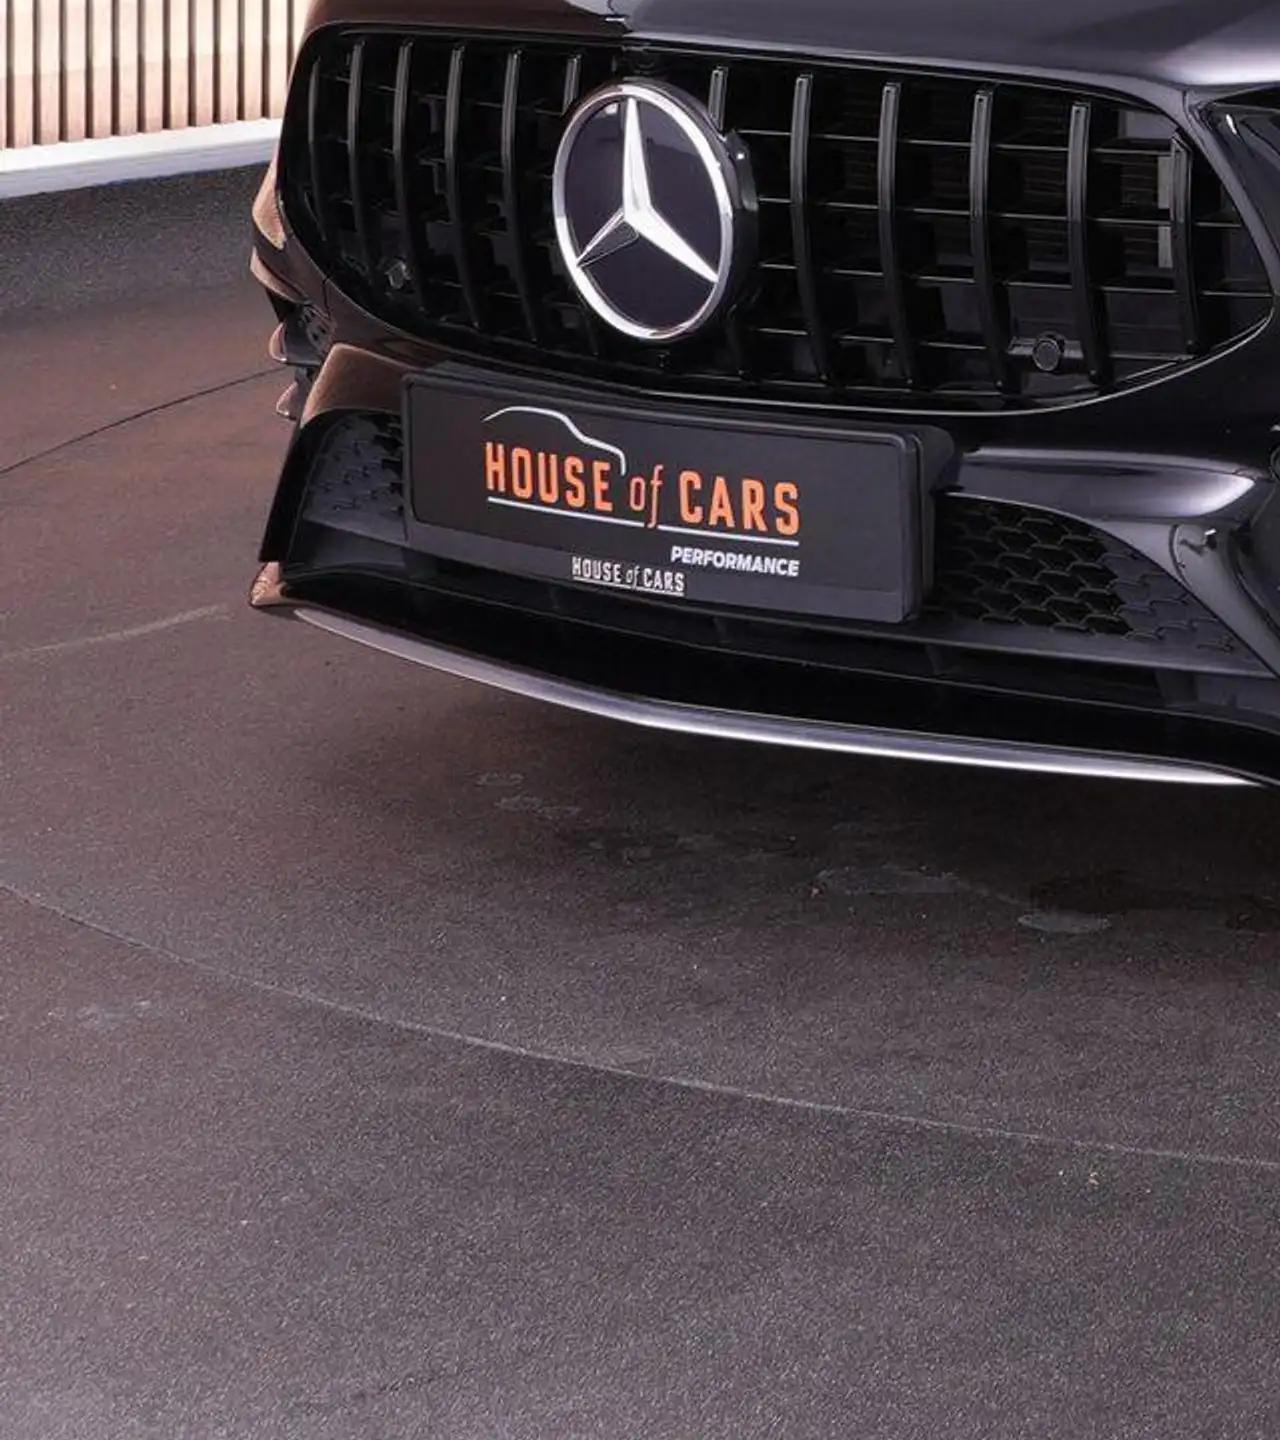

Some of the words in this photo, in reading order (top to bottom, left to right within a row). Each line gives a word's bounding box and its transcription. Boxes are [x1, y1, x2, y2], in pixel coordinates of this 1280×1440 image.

[485, 441, 614, 513] HOUSE
[630, 464, 665, 529] of
[678, 470, 801, 536] CARS
[572, 556, 622, 583] HOUSE
[625, 565, 640, 588] of
[643, 567, 685, 592] CARS
[670, 545, 801, 577] PERFORMANCE
